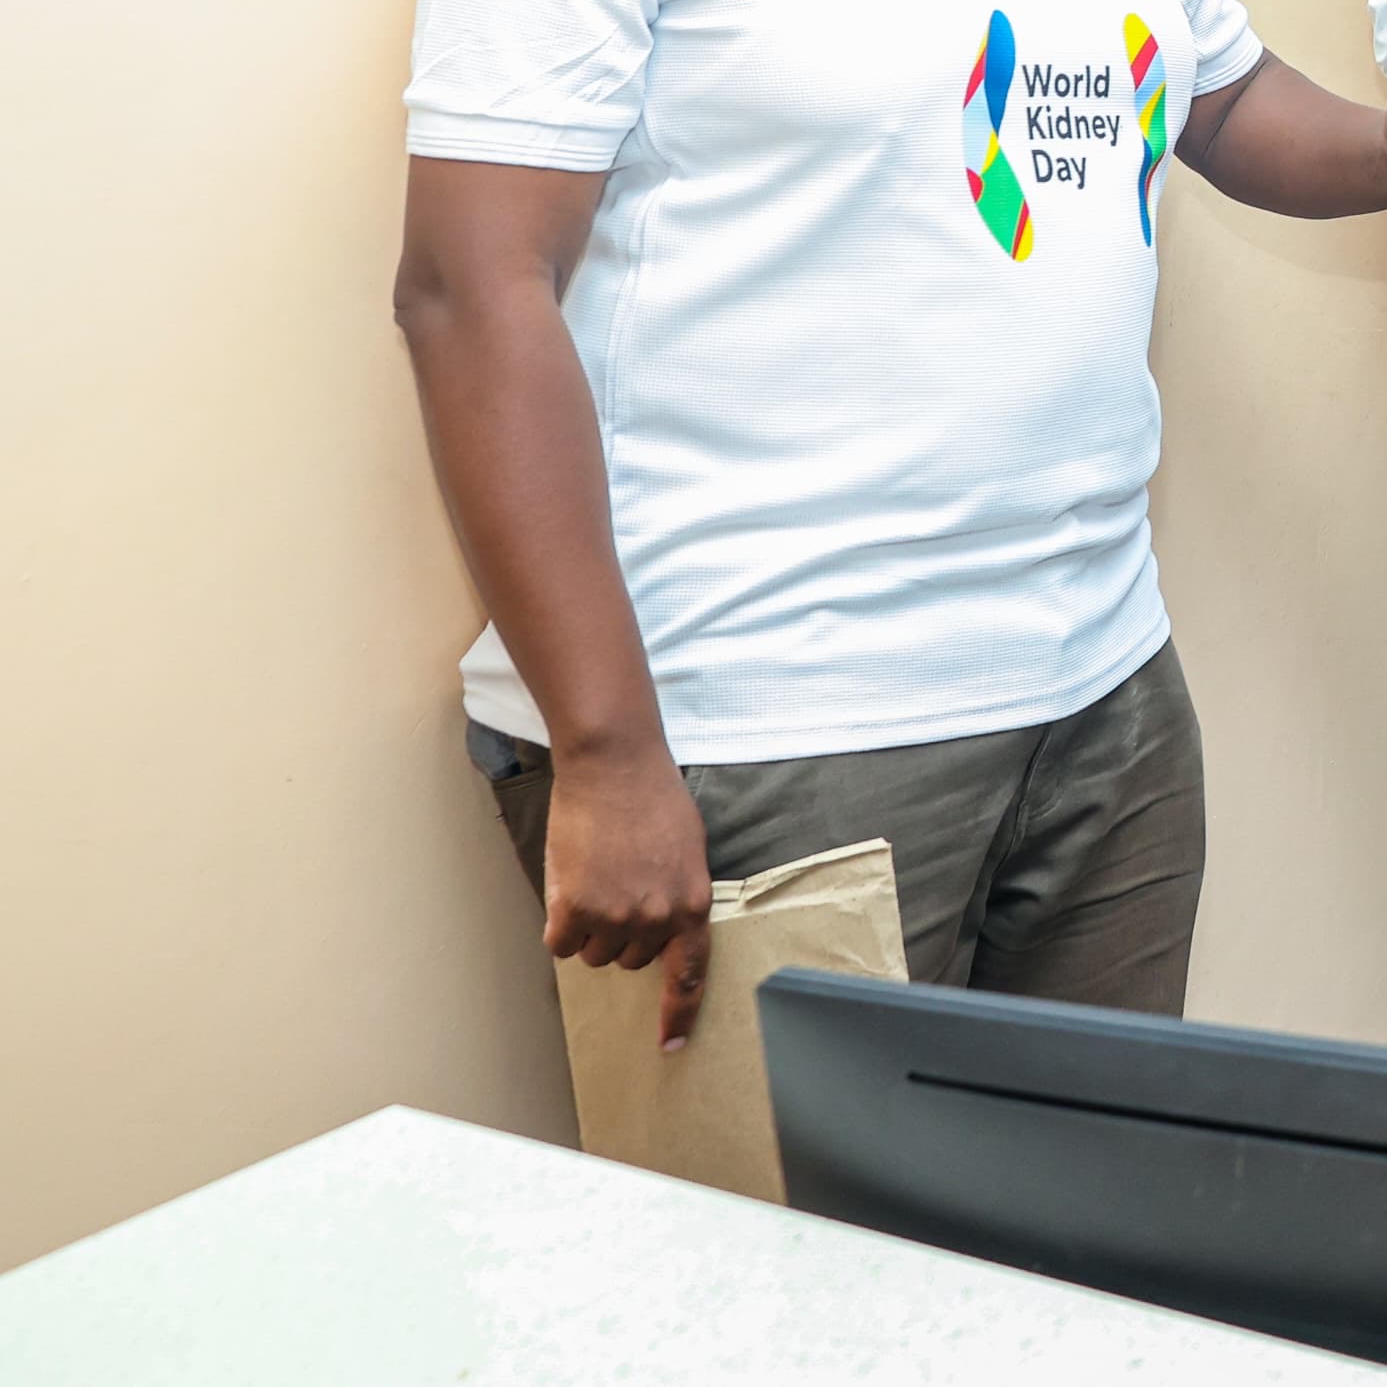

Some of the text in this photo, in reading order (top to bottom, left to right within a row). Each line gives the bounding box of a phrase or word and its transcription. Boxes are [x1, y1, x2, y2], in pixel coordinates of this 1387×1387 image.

[1022, 64, 1111, 99] World
[1026, 105, 1121, 146] Kidney
[1031, 149, 1088, 190] Day
